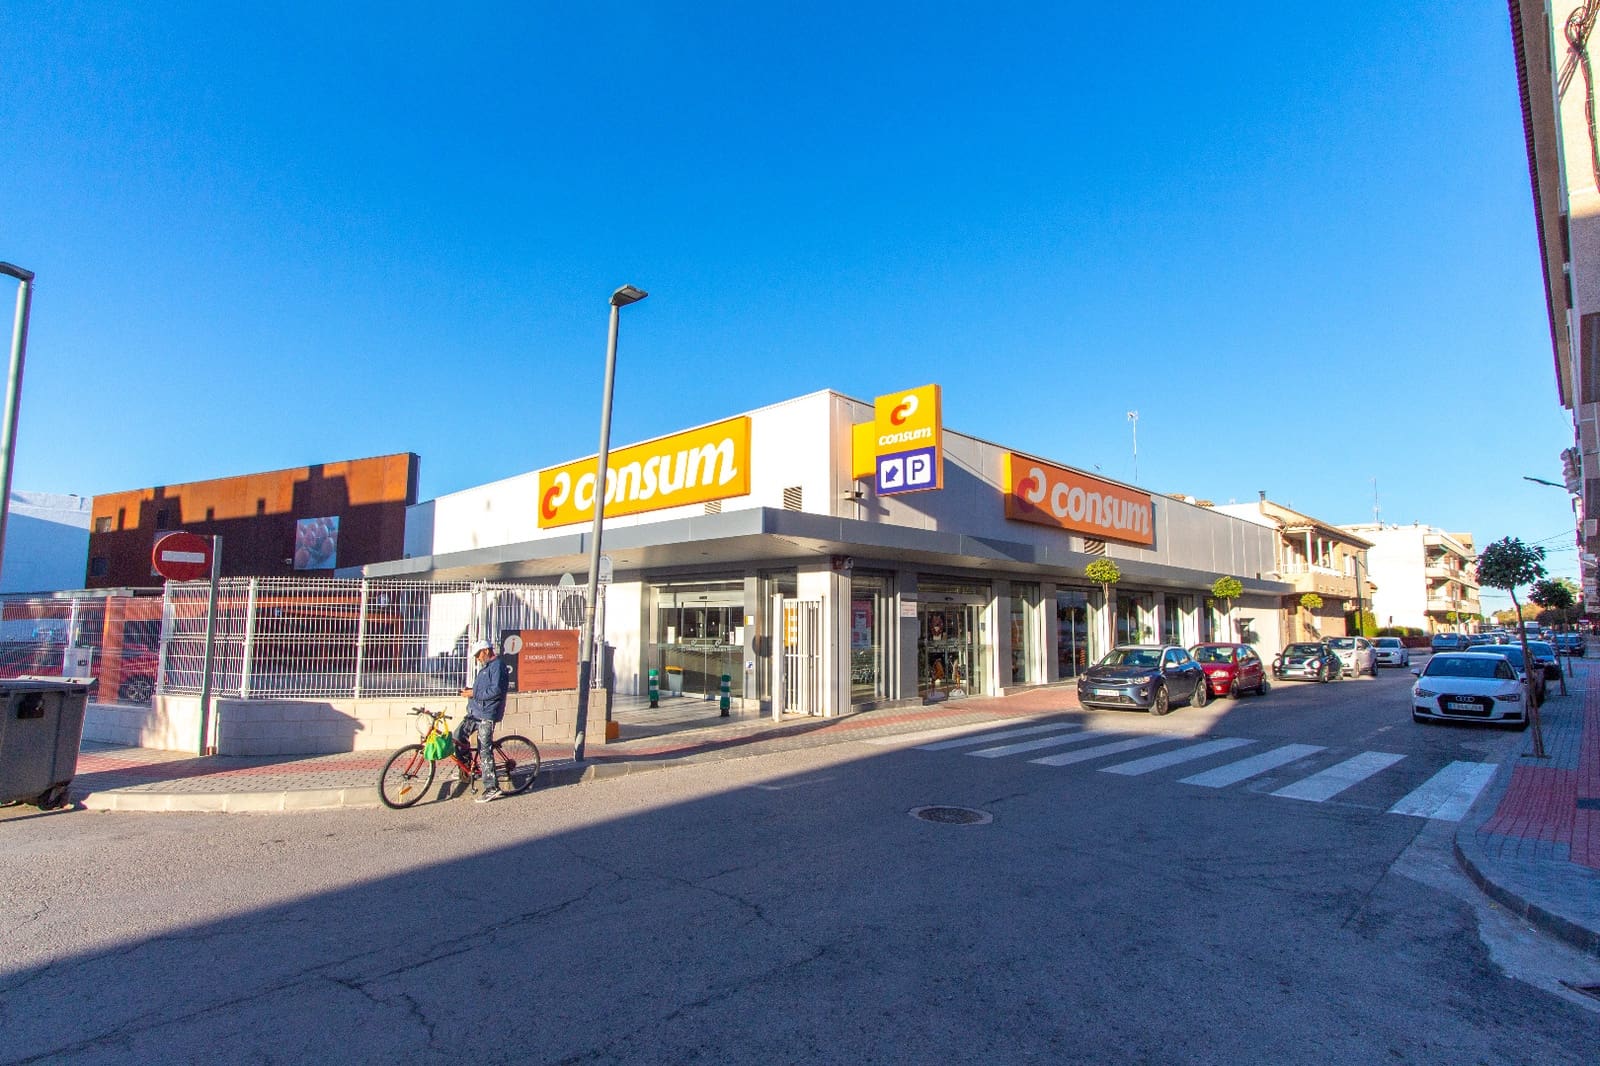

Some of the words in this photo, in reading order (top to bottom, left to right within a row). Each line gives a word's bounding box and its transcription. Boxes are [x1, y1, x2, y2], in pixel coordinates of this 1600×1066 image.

[879, 427, 931, 446] consum
[574, 438, 737, 511] consum
[912, 459, 925, 480] P
[1051, 482, 1149, 536] consum
